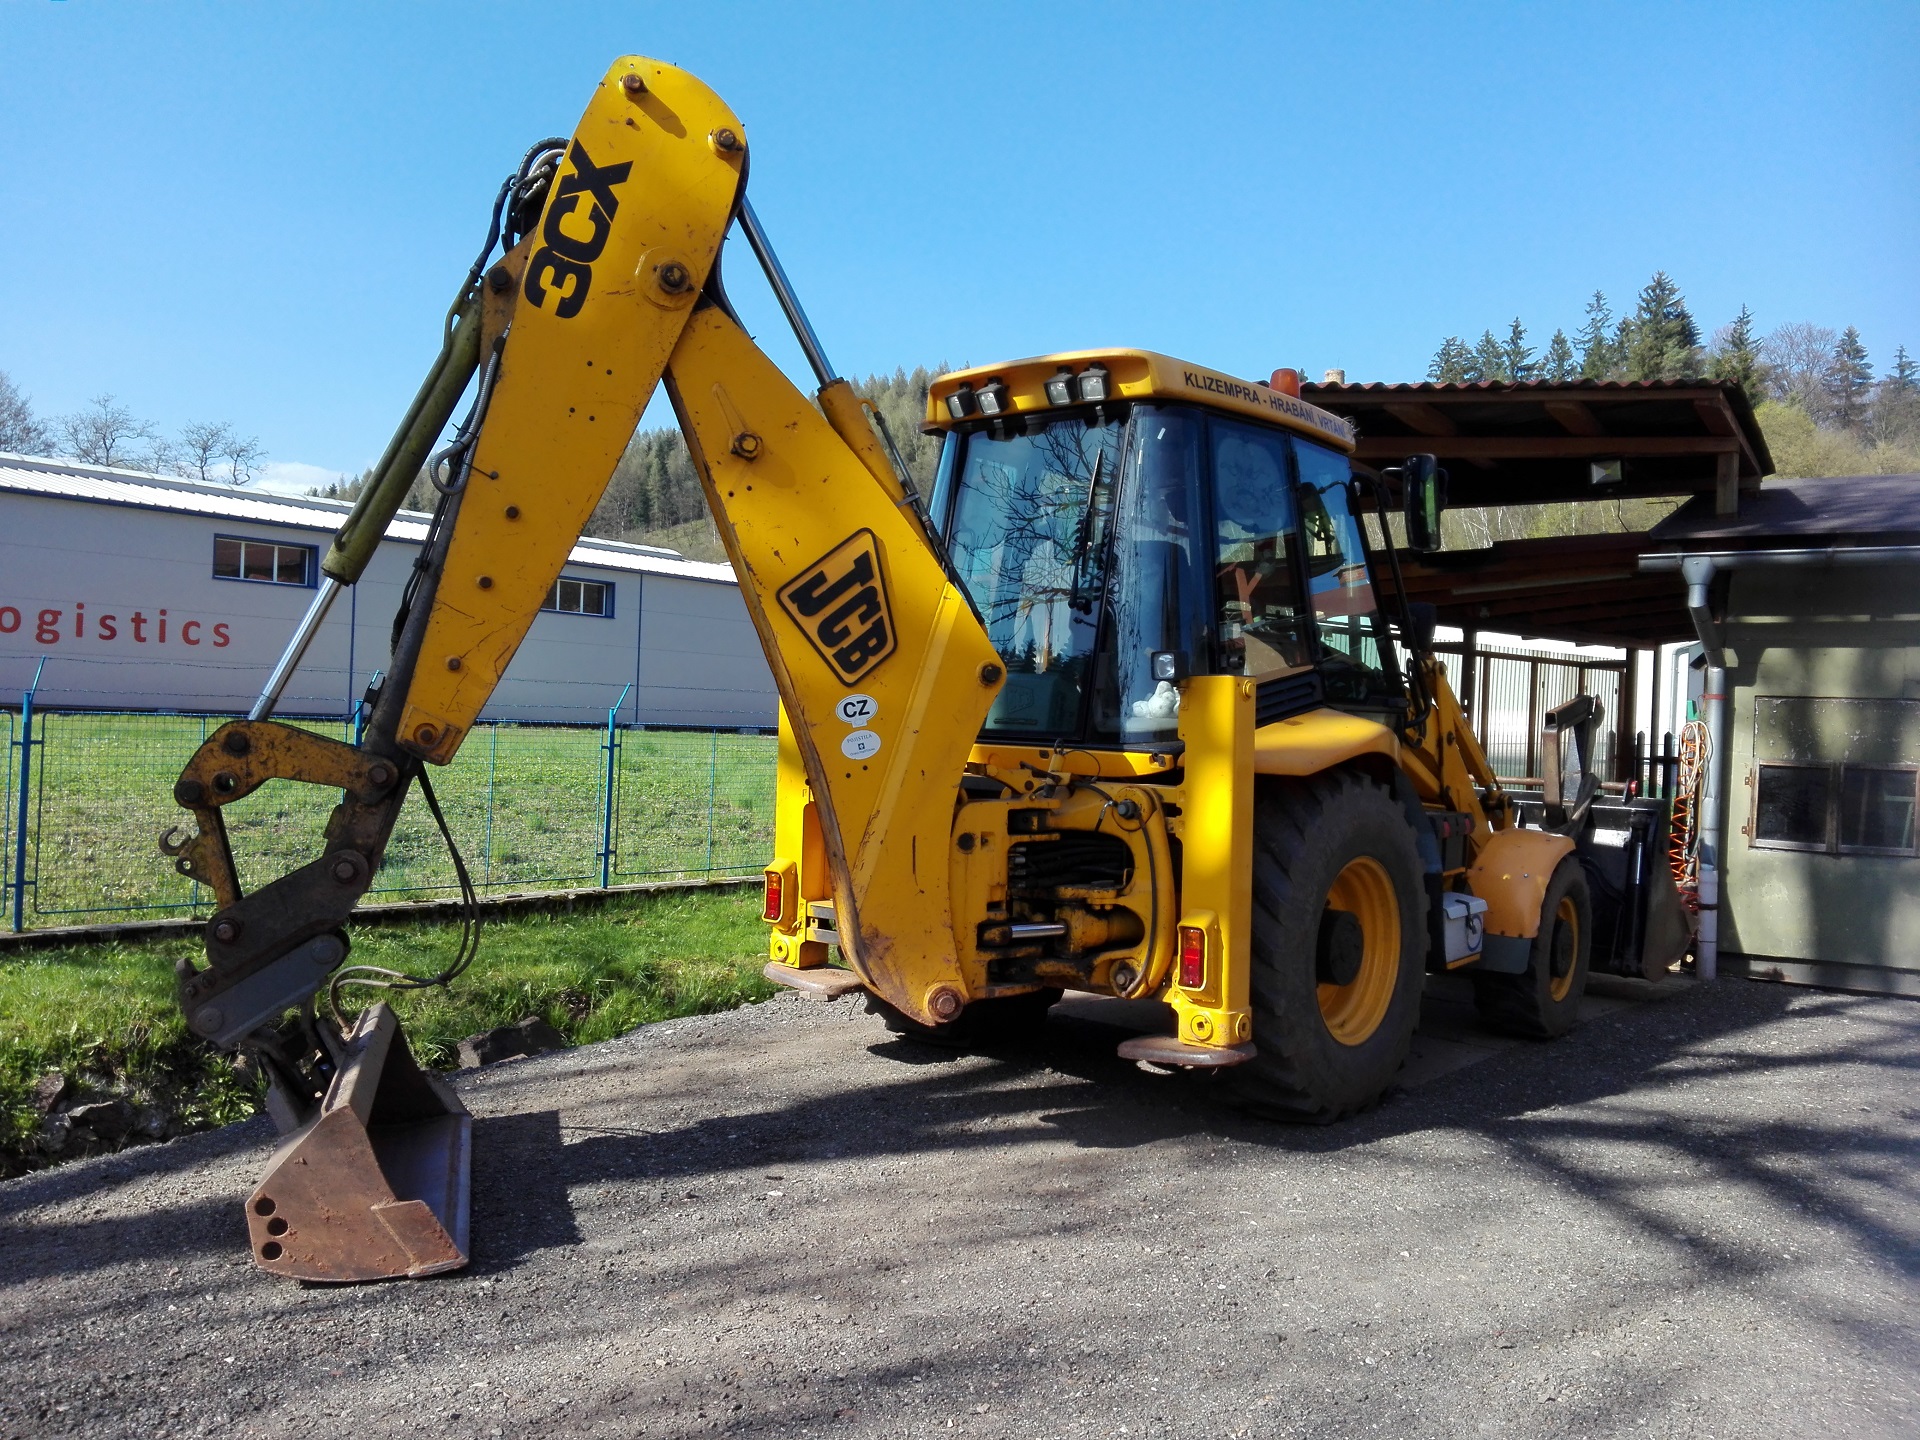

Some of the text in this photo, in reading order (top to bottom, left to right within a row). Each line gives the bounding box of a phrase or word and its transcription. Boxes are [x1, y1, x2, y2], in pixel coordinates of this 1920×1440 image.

[524, 137, 634, 319] 3CX
[1184, 371, 1261, 405] KLIZEMPRA
[787, 550, 888, 674] JCB
[843, 699, 870, 718] CZ
